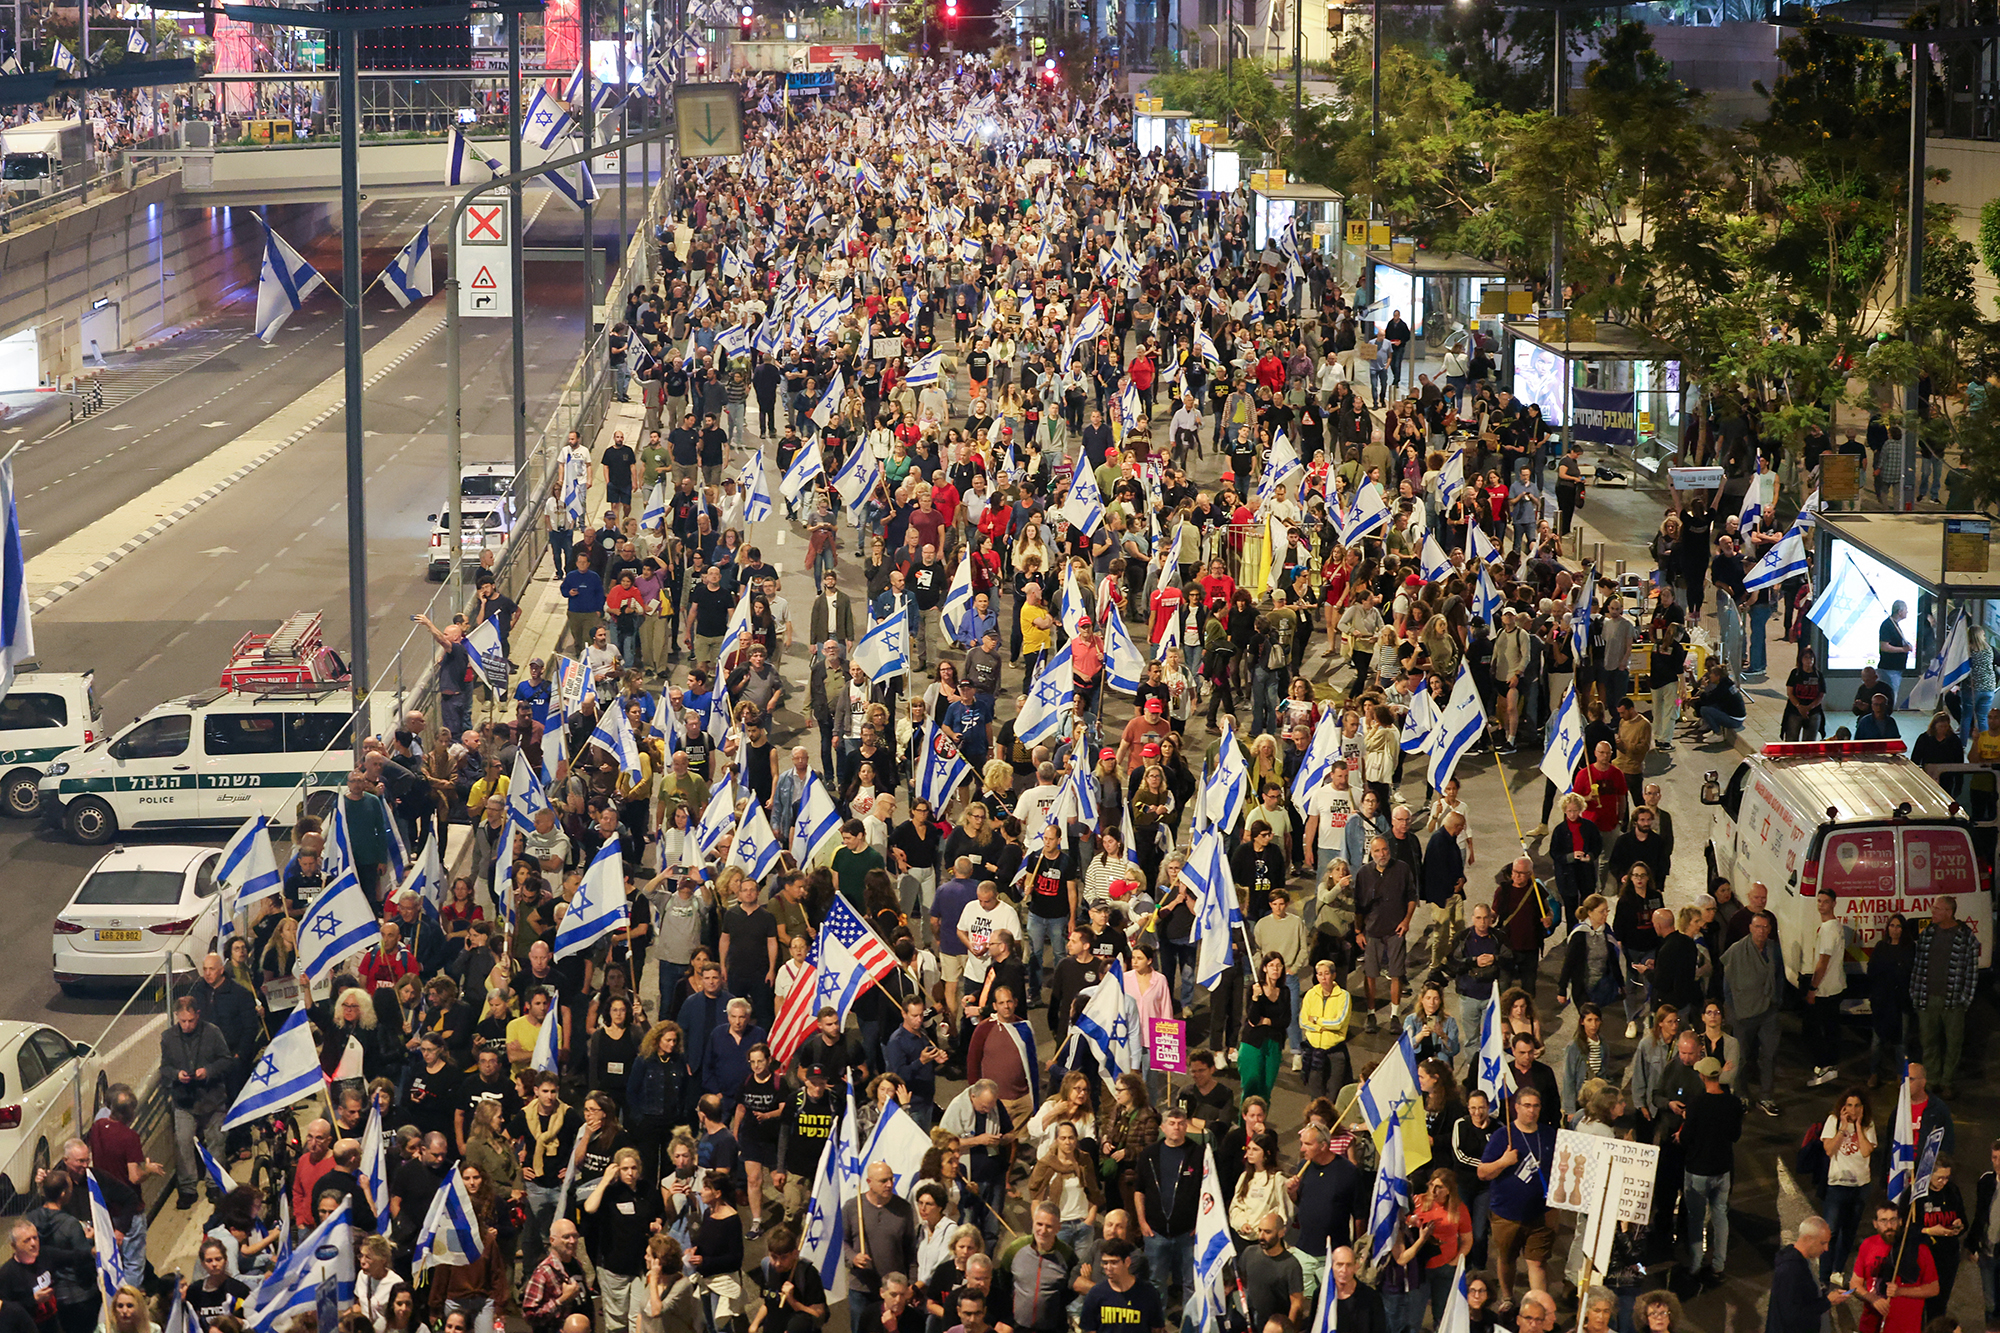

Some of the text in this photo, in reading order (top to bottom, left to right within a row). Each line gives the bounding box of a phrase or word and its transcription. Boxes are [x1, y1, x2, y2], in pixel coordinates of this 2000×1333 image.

[1604, 410, 1633, 430] מאבק
[129, 775, 261, 790] משמר הגבול
[139, 796, 174, 804] POLICE
[216, 792, 252, 803] الشرطة
[1333, 799, 1348, 807] אתה
[1330, 806, 1351, 814] הראש
[1863, 849, 1893, 859] הורידו
[1933, 851, 1967, 868] מציל
[1934, 867, 1967, 881] חיים
[1846, 898, 1934, 914] AMBULAN
[974, 916, 993, 927] אתה
[1853, 915, 1869, 925] דוד
[101, 931, 113, 940] 466
[115, 931, 125, 940] 28
[971, 925, 993, 937] הראש
[972, 933, 989, 944] אתה
[1158, 1053, 1179, 1061] חיים
[799, 1114, 831, 1126] הדחה
[1602, 1141, 1655, 1157] לאן הלך ילדי
[1613, 1154, 1653, 1168] ילדי הסור
[1623, 1176, 1650, 1188] בכי בח
[1619, 1198, 1648, 1210] על לוח
[1619, 1208, 1646, 1221] רק מל
[1923, 1210, 1957, 1227] NOW!
[1101, 1305, 1141, 1325] בחירות!
